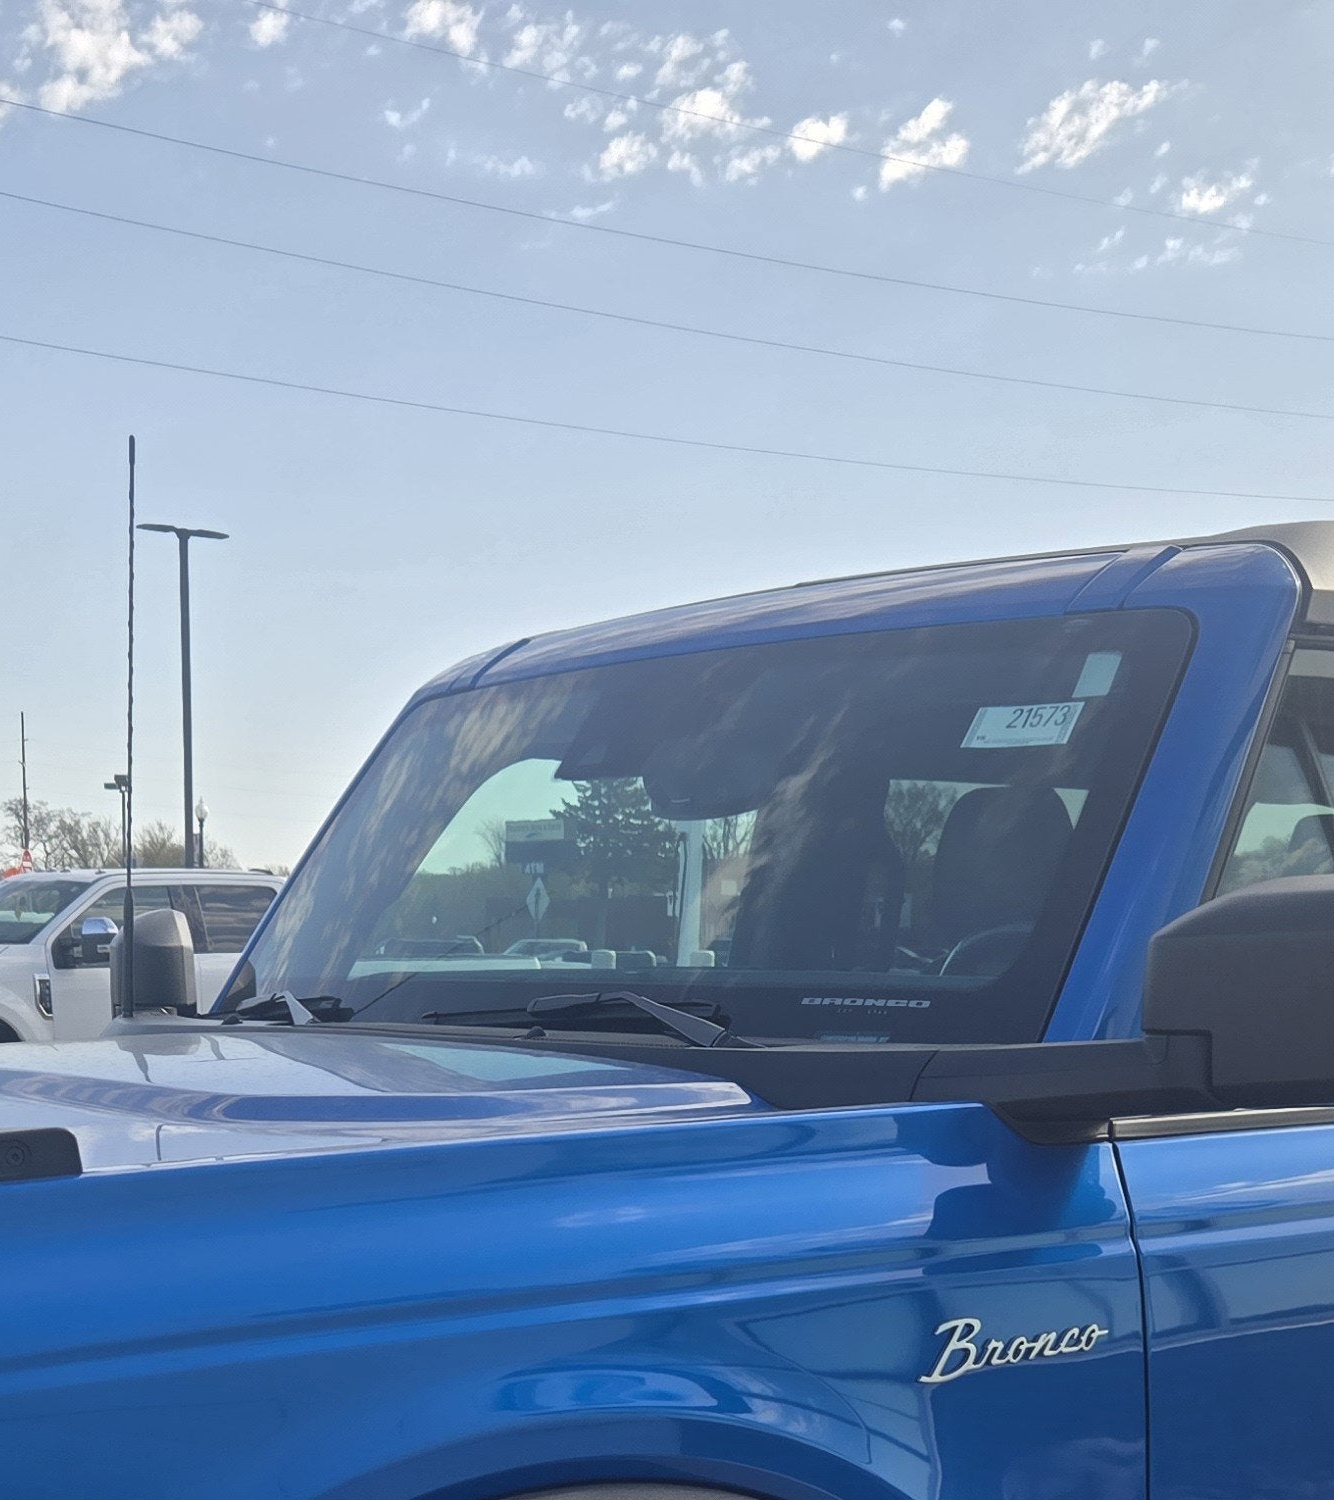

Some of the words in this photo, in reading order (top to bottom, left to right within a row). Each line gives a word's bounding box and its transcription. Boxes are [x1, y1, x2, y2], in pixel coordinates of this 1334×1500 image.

[1005, 705, 1072, 729] 21573
[801, 997, 931, 1009] BRONCO
[919, 1318, 1109, 1383] Bronco
